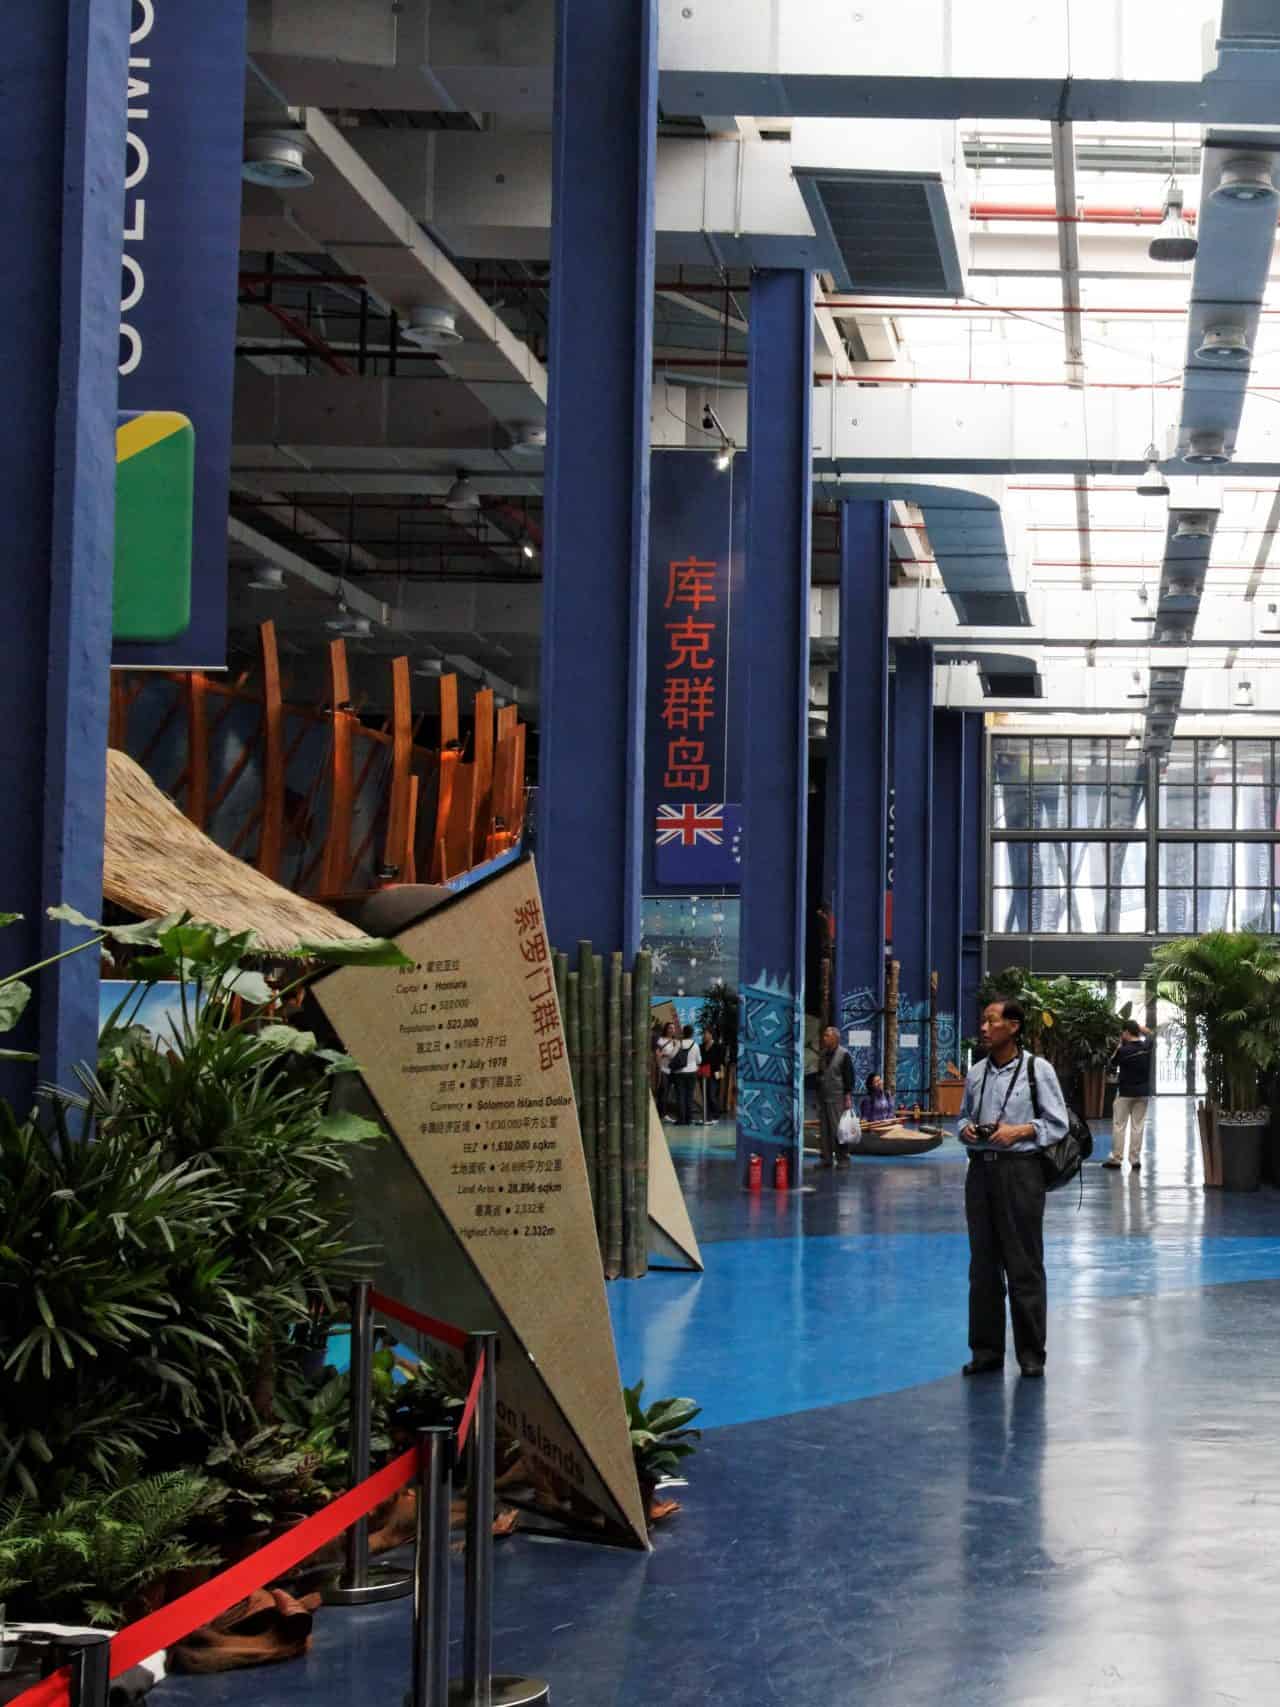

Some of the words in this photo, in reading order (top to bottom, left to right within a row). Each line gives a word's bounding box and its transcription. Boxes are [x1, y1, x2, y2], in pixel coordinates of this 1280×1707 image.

[660, 555, 719, 791] 库克群岛
[477, 1099, 515, 1111] Solomon
[517, 1097, 543, 1109] Island
[546, 1095, 573, 1107] Dollar
[532, 1139, 557, 1152] sqkm
